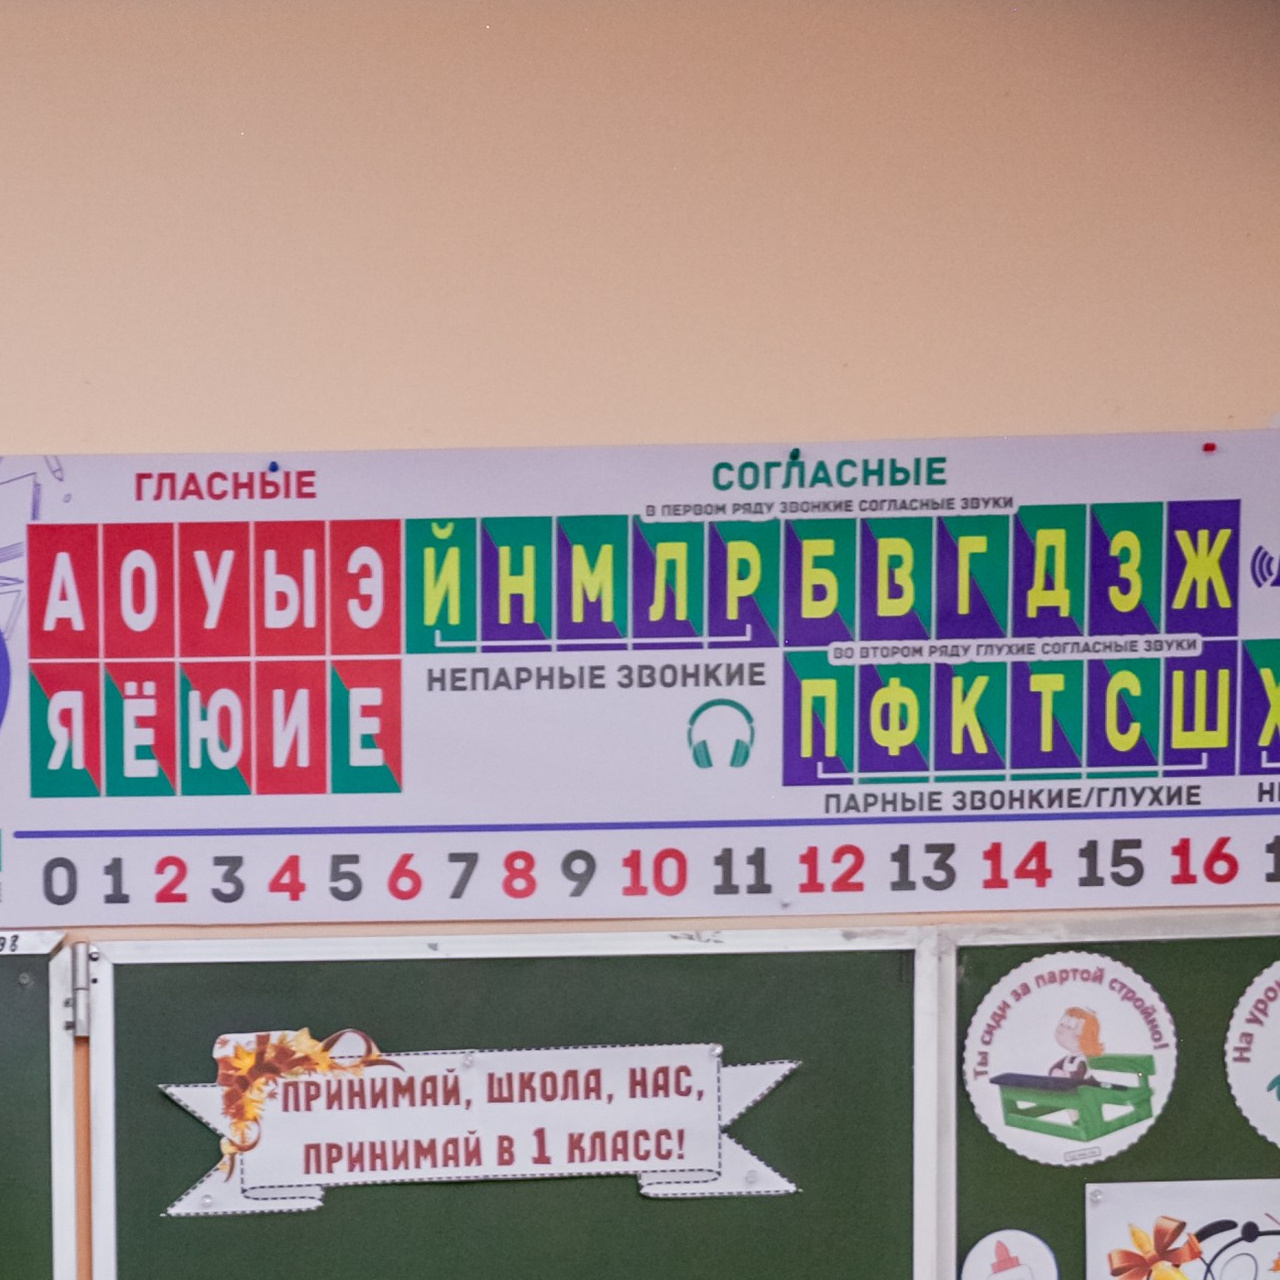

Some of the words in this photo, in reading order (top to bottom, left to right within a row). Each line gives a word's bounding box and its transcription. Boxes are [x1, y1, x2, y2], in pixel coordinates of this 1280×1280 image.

[135, 470, 317, 501] ГЛАСНЫЕ
[712, 457, 948, 490] СОГЛАСНЫЕ
[645, 505, 655, 516] В
[661, 503, 727, 516] ПЕРВОМ
[731, 502, 773, 515] РЯДУ
[780, 500, 852, 513] ЗВОНКИЕ
[858, 498, 957, 512] СОГЛАСНЫЕ
[960, 496, 1013, 510] ЗВУКИ
[43, 552, 85, 632] А
[120, 549, 158, 632] О
[194, 549, 234, 630] У
[263, 548, 316, 629] Ы
[347, 546, 385, 629] Э
[423, 521, 461, 626] Й
[497, 545, 536, 625] Н
[572, 544, 614, 623] М
[649, 541, 688, 622] Л
[726, 540, 761, 620] Р
[801, 539, 838, 619] Б
[877, 537, 914, 617] В
[957, 536, 987, 615] Г
[1026, 528, 1070, 617] Д
[1108, 530, 1142, 613] З
[1172, 528, 1232, 609] Ж
[834, 647, 854, 659] ВО
[860, 645, 923, 658] ВТОРОМ
[928, 644, 971, 657] РЯДУ
[976, 643, 1035, 656] ГЛУХИЕ
[1041, 640, 1139, 654] СОГЛАСНЫЕ
[1144, 638, 1197, 652] ЗВУКИ
[426, 665, 606, 692] НЕПАРНЫЕ
[614, 662, 767, 688] ЗВОНКИЕ
[46, 690, 84, 770] Я
[123, 681, 159, 778] Ё
[188, 687, 243, 770] Ю
[273, 688, 309, 768] И
[349, 687, 384, 766] Е
[800, 679, 837, 759] П
[870, 676, 919, 756] Ф
[951, 675, 989, 754] К
[1029, 673, 1065, 752] Т
[1105, 670, 1142, 752] С
[1171, 669, 1228, 749] Ш
[824, 788, 942, 814] ПАРНЫЕ
[951, 785, 1202, 812] ЗВОНКИЕ/ГЛУХИЕ
[42, 857, 78, 906] 0
[102, 857, 129, 904] 1
[154, 856, 188, 903] 2
[211, 855, 245, 903] 3
[268, 855, 306, 902] 4
[329, 854, 363, 901] 5
[387, 853, 422, 900] 6
[447, 852, 479, 899] 7
[501, 850, 537, 899] 8
[561, 849, 597, 898] 9
[621, 848, 689, 897] 10
[712, 847, 773, 895] 11
[798, 845, 865, 893] 12
[889, 843, 957, 892] 13
[982, 842, 1053, 889] 14
[1077, 839, 1145, 888] 15
[1170, 837, 1239, 885] 16
[1011, 982, 1031, 1002] за
[1035, 966, 1105, 989] партой
[981, 1000, 1011, 1046] сиди
[1108, 978, 1170, 1050] стройно!
[1232, 1032, 1254, 1063] На
[1245, 980, 1280, 1027] уро
[974, 1051, 989, 1080] Ты
[281, 1067, 473, 1113] ПРИНИМАЙ,
[486, 1069, 613, 1104] ШКОЛА,
[628, 1065, 705, 1103] НАС,
[304, 1130, 482, 1175] ПРИНИМАЙ
[496, 1135, 516, 1167] В
[531, 1128, 552, 1165] 1
[566, 1128, 686, 1164] КЛАСС!
